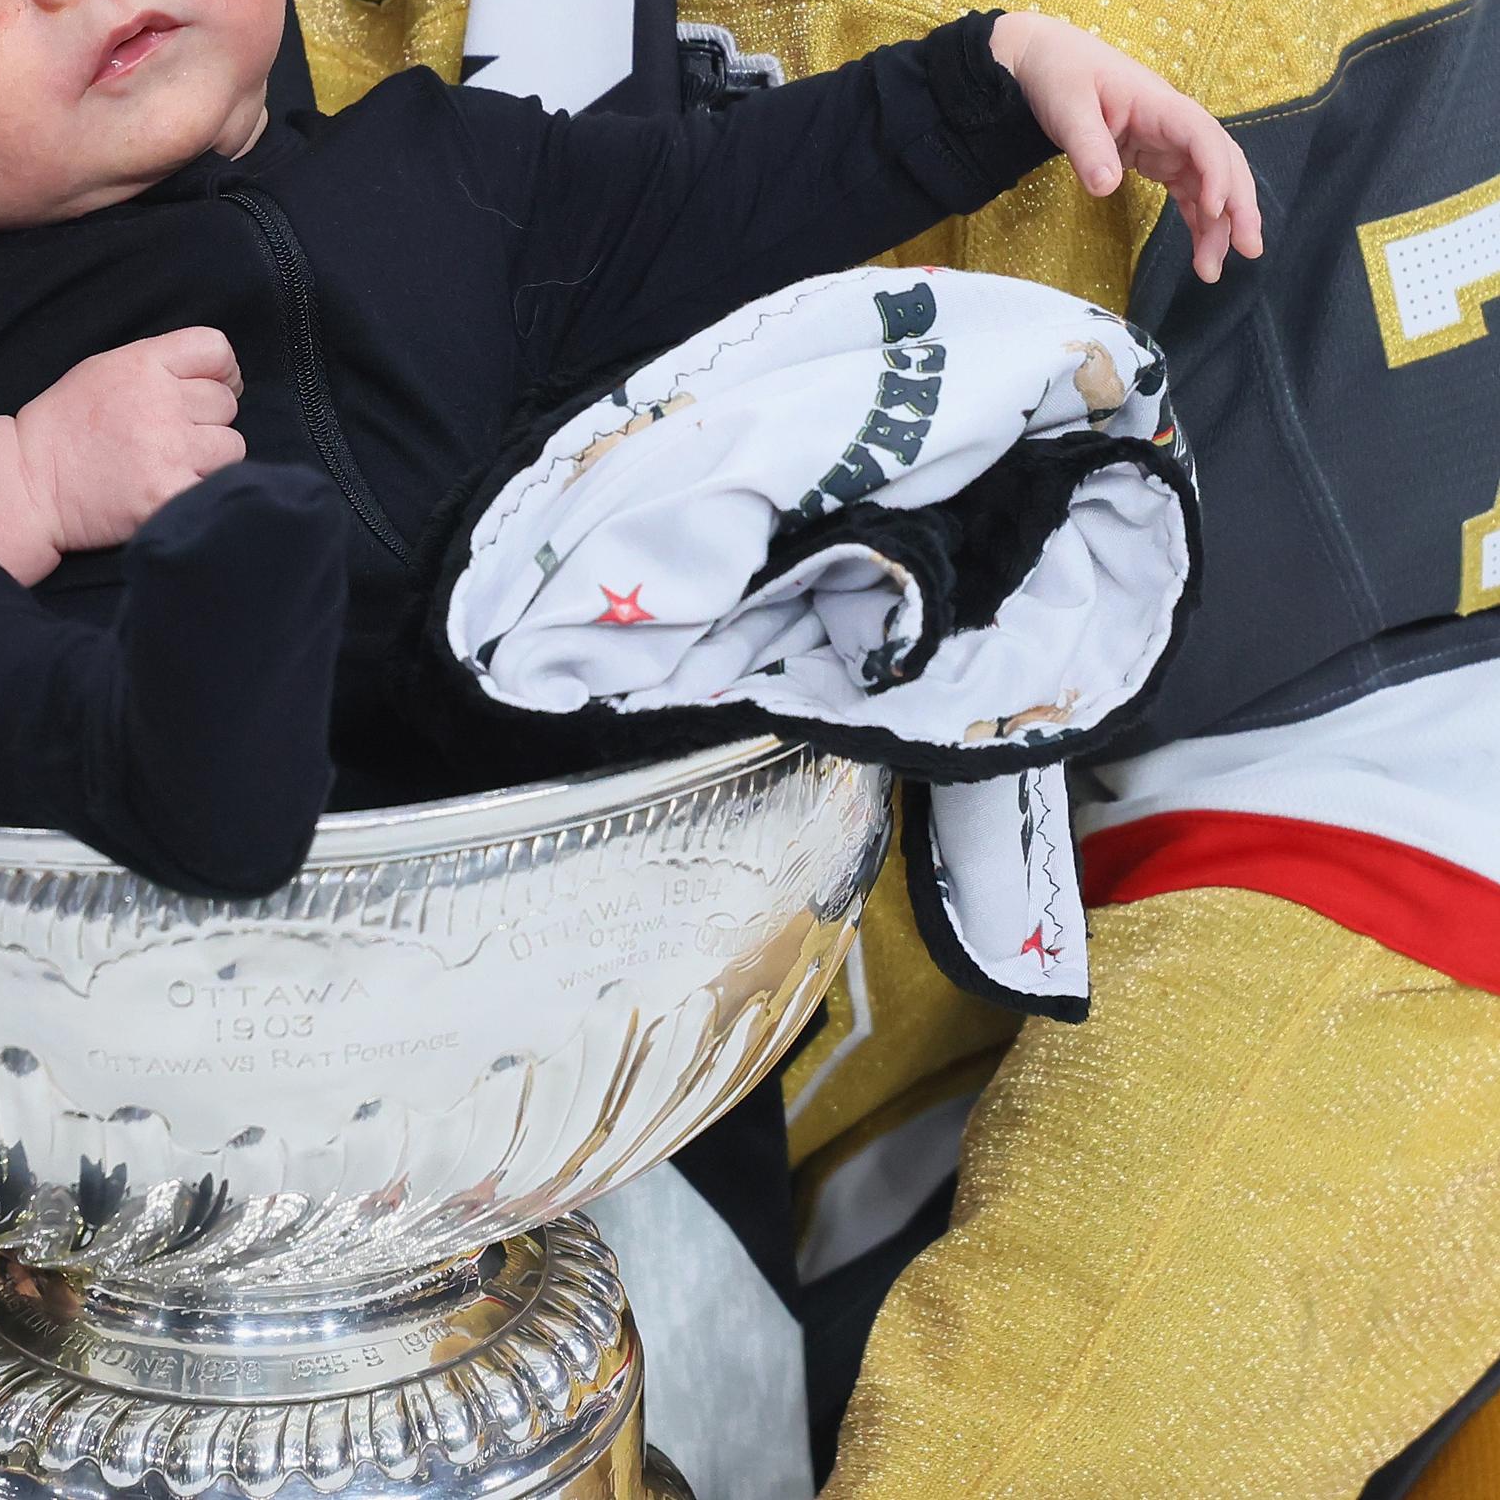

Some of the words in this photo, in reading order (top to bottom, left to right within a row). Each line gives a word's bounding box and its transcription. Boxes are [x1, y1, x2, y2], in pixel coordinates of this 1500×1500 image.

[508, 891, 643, 961] OTTAWA
[662, 878, 722, 906] 1904
[167, 979, 371, 1008] OTTAWA
[215, 1014, 315, 1043] 1903
[88, 1049, 213, 1073] OTTAWA
[271, 1048, 333, 1070] RAT
[344, 1031, 460, 1065] PORTAGE
